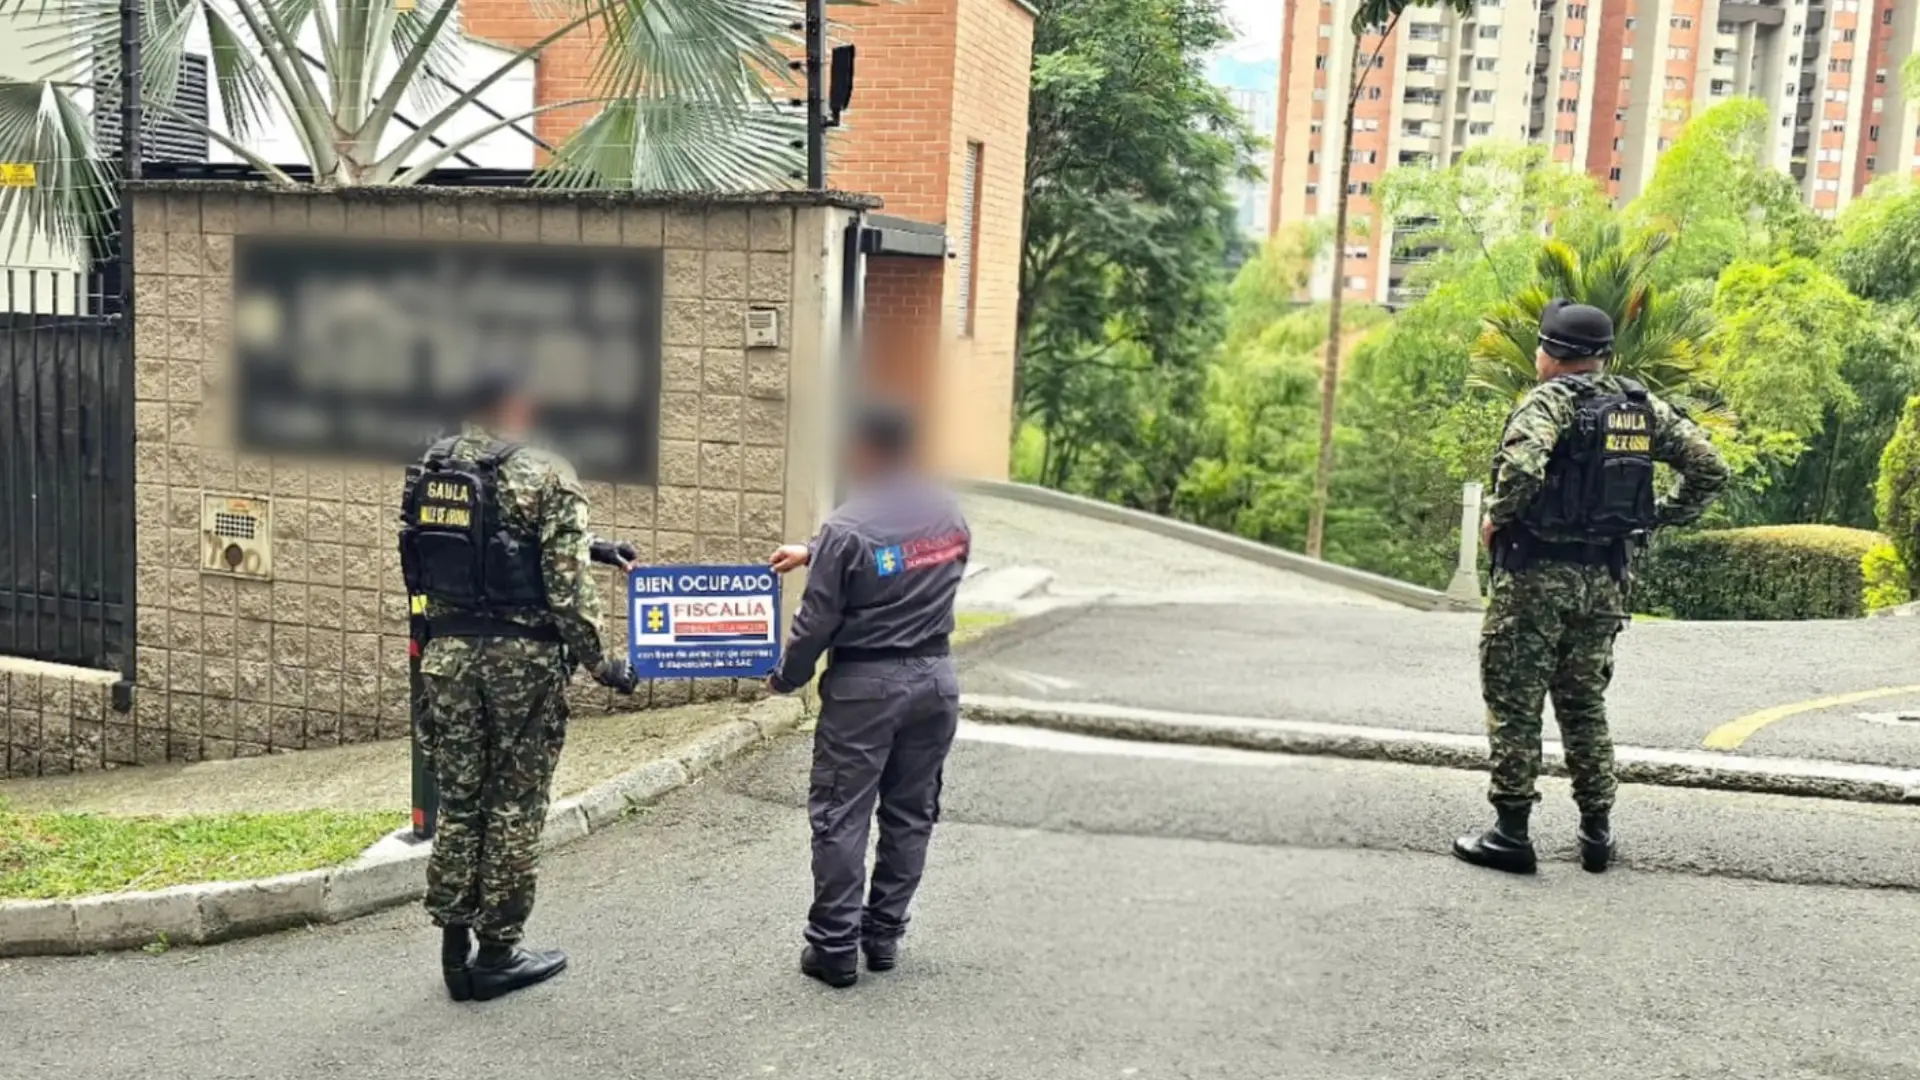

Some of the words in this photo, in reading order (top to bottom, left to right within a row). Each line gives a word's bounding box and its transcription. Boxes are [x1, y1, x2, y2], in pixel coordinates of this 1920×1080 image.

[635, 575, 674, 593] BIEN
[678, 574, 773, 592] OCUPADO
[674, 600, 767, 617] FISCALÍA
